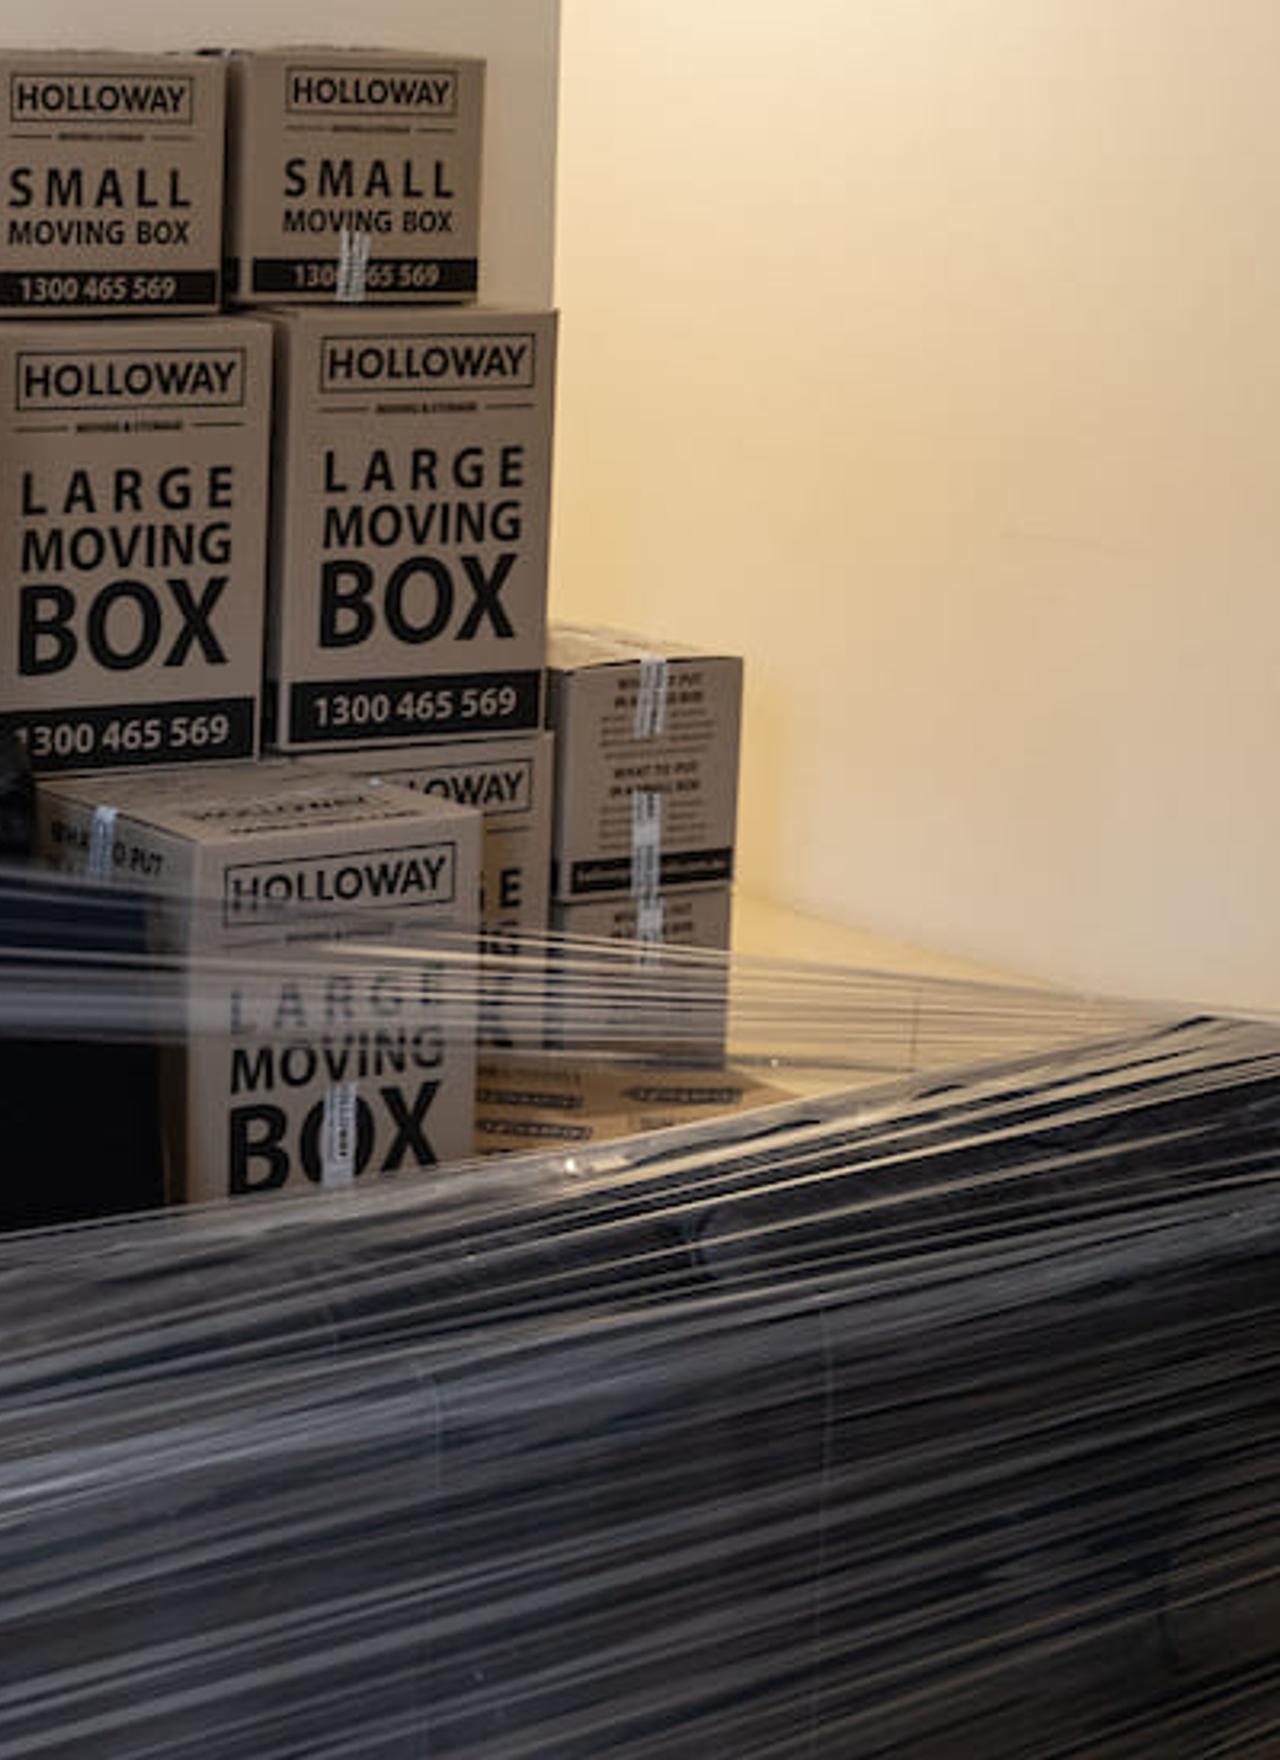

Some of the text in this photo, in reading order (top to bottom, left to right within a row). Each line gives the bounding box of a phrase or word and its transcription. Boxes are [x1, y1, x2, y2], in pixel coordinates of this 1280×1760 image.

[17, 85, 186, 114] HOLLOWAY
[293, 77, 450, 106] HOLLOWAY
[8, 168, 192, 208] SMALL
[284, 158, 454, 198] SMALL
[8, 220, 190, 246] MOVING BOX
[283, 209, 453, 234] MOVING BOX
[21, 276, 176, 301] 1300 465 569
[294, 263, 440, 288] 130 65 569
[24, 361, 237, 398] HOLLOWAY
[328, 344, 528, 380] HOLLOWAY
[323, 445, 525, 494] LARGE
[21, 465, 233, 516] LARGE
[322, 499, 522, 549] MOVING
[21, 521, 232, 574] MOVING
[318, 552, 518, 650] BOX
[17, 576, 230, 677] BOX
[315, 686, 518, 726] 1300 465 569
[101, 718, 161, 749] 465
[169, 714, 230, 745] 569
[231, 855, 447, 913] HOLLOWAY
[229, 1025, 446, 1096] MOVING
[228, 1078, 444, 1198] BOX
